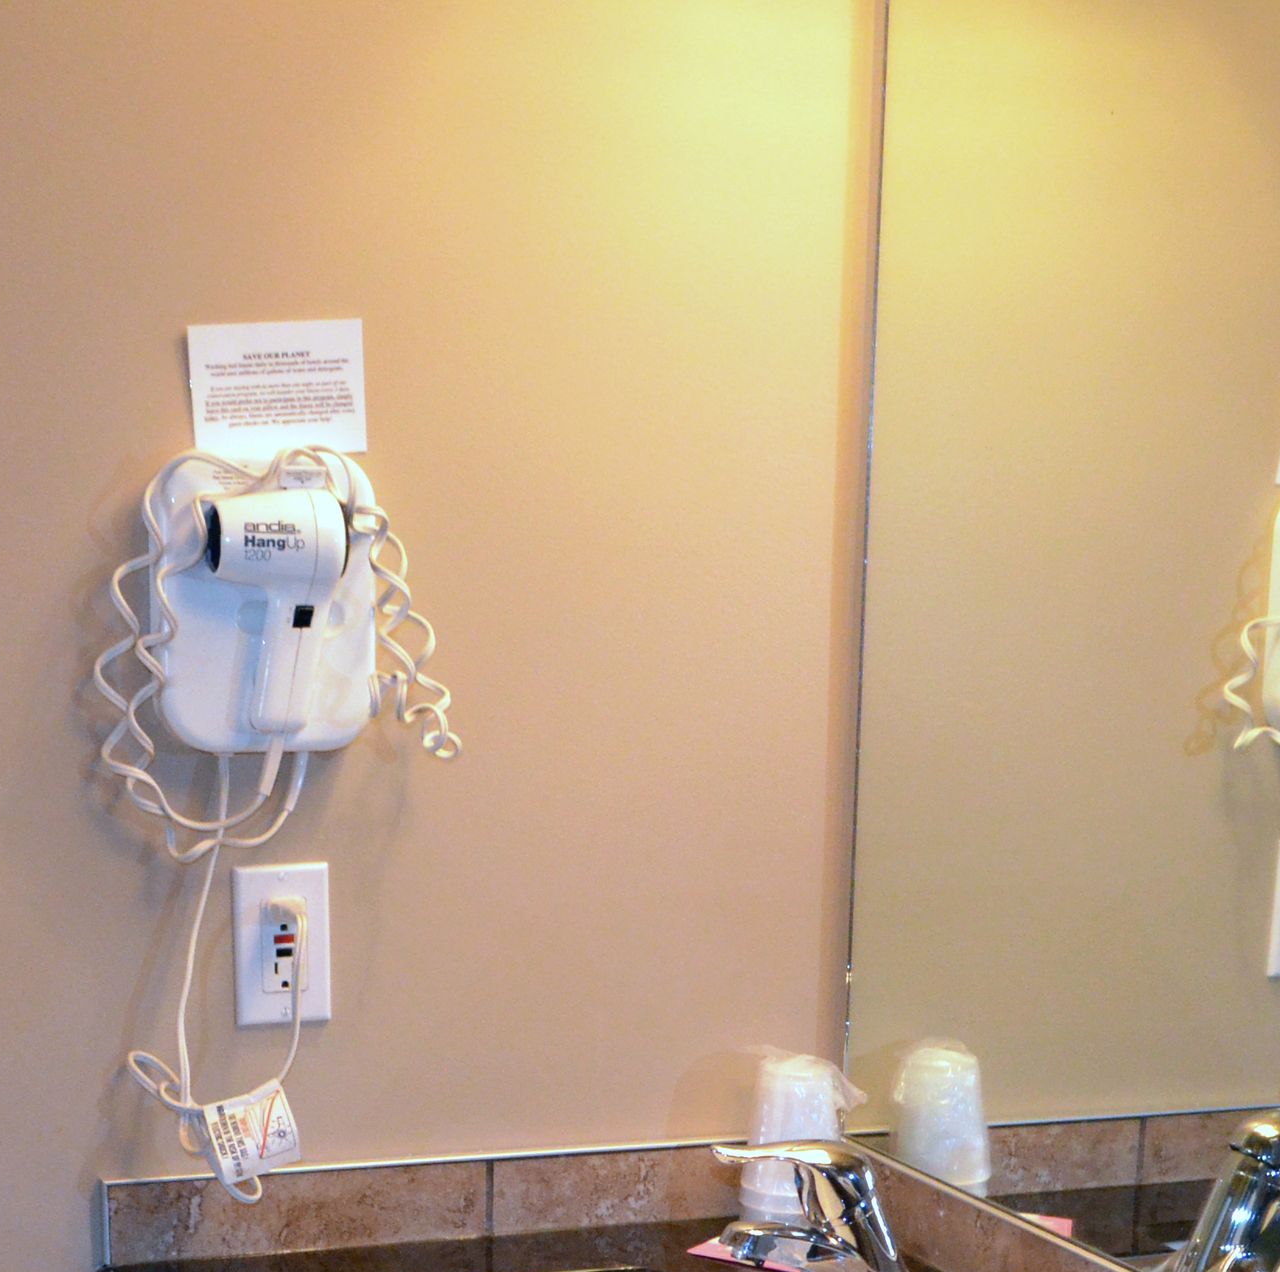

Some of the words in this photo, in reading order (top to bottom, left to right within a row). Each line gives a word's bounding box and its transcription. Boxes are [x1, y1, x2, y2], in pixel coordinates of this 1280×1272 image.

[264, 352, 280, 360] OUR
[281, 350, 311, 359] PLANET
[244, 535, 306, 551] HangUp
[244, 549, 272, 561] 1200
